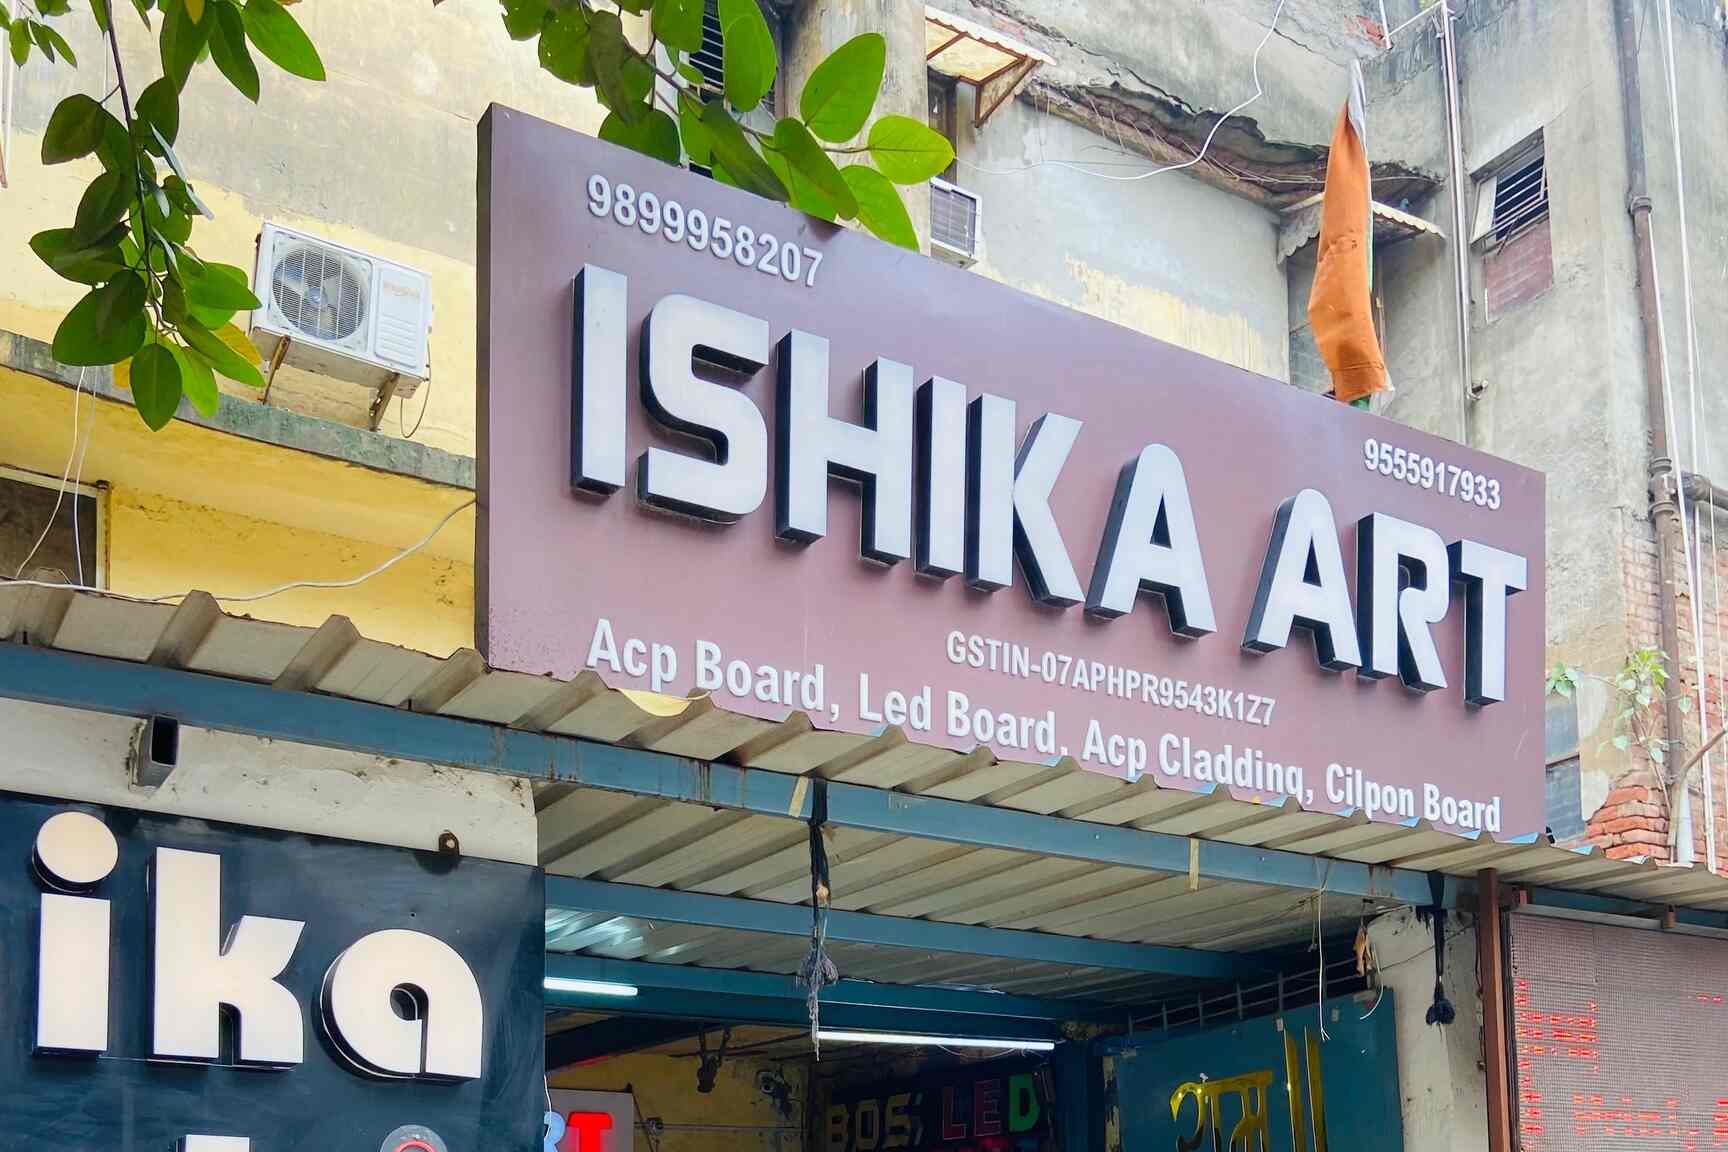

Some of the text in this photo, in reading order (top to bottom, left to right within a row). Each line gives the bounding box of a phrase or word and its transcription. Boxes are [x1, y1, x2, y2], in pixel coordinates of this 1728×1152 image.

[586, 174, 823, 287] 9899958207
[573, 264, 1528, 707] ISHIKA ART
[1364, 438, 1502, 511] 9555917933
[585, 618, 678, 693] Acp
[695, 639, 840, 723] Board,
[858, 672, 932, 732] Led
[1081, 719, 1148, 781] Acp
[1325, 763, 1415, 819] Cilpon
[1423, 783, 1501, 833] Board
[946, 630, 1276, 727] GSTIN-07APHPR9543K1Z7
